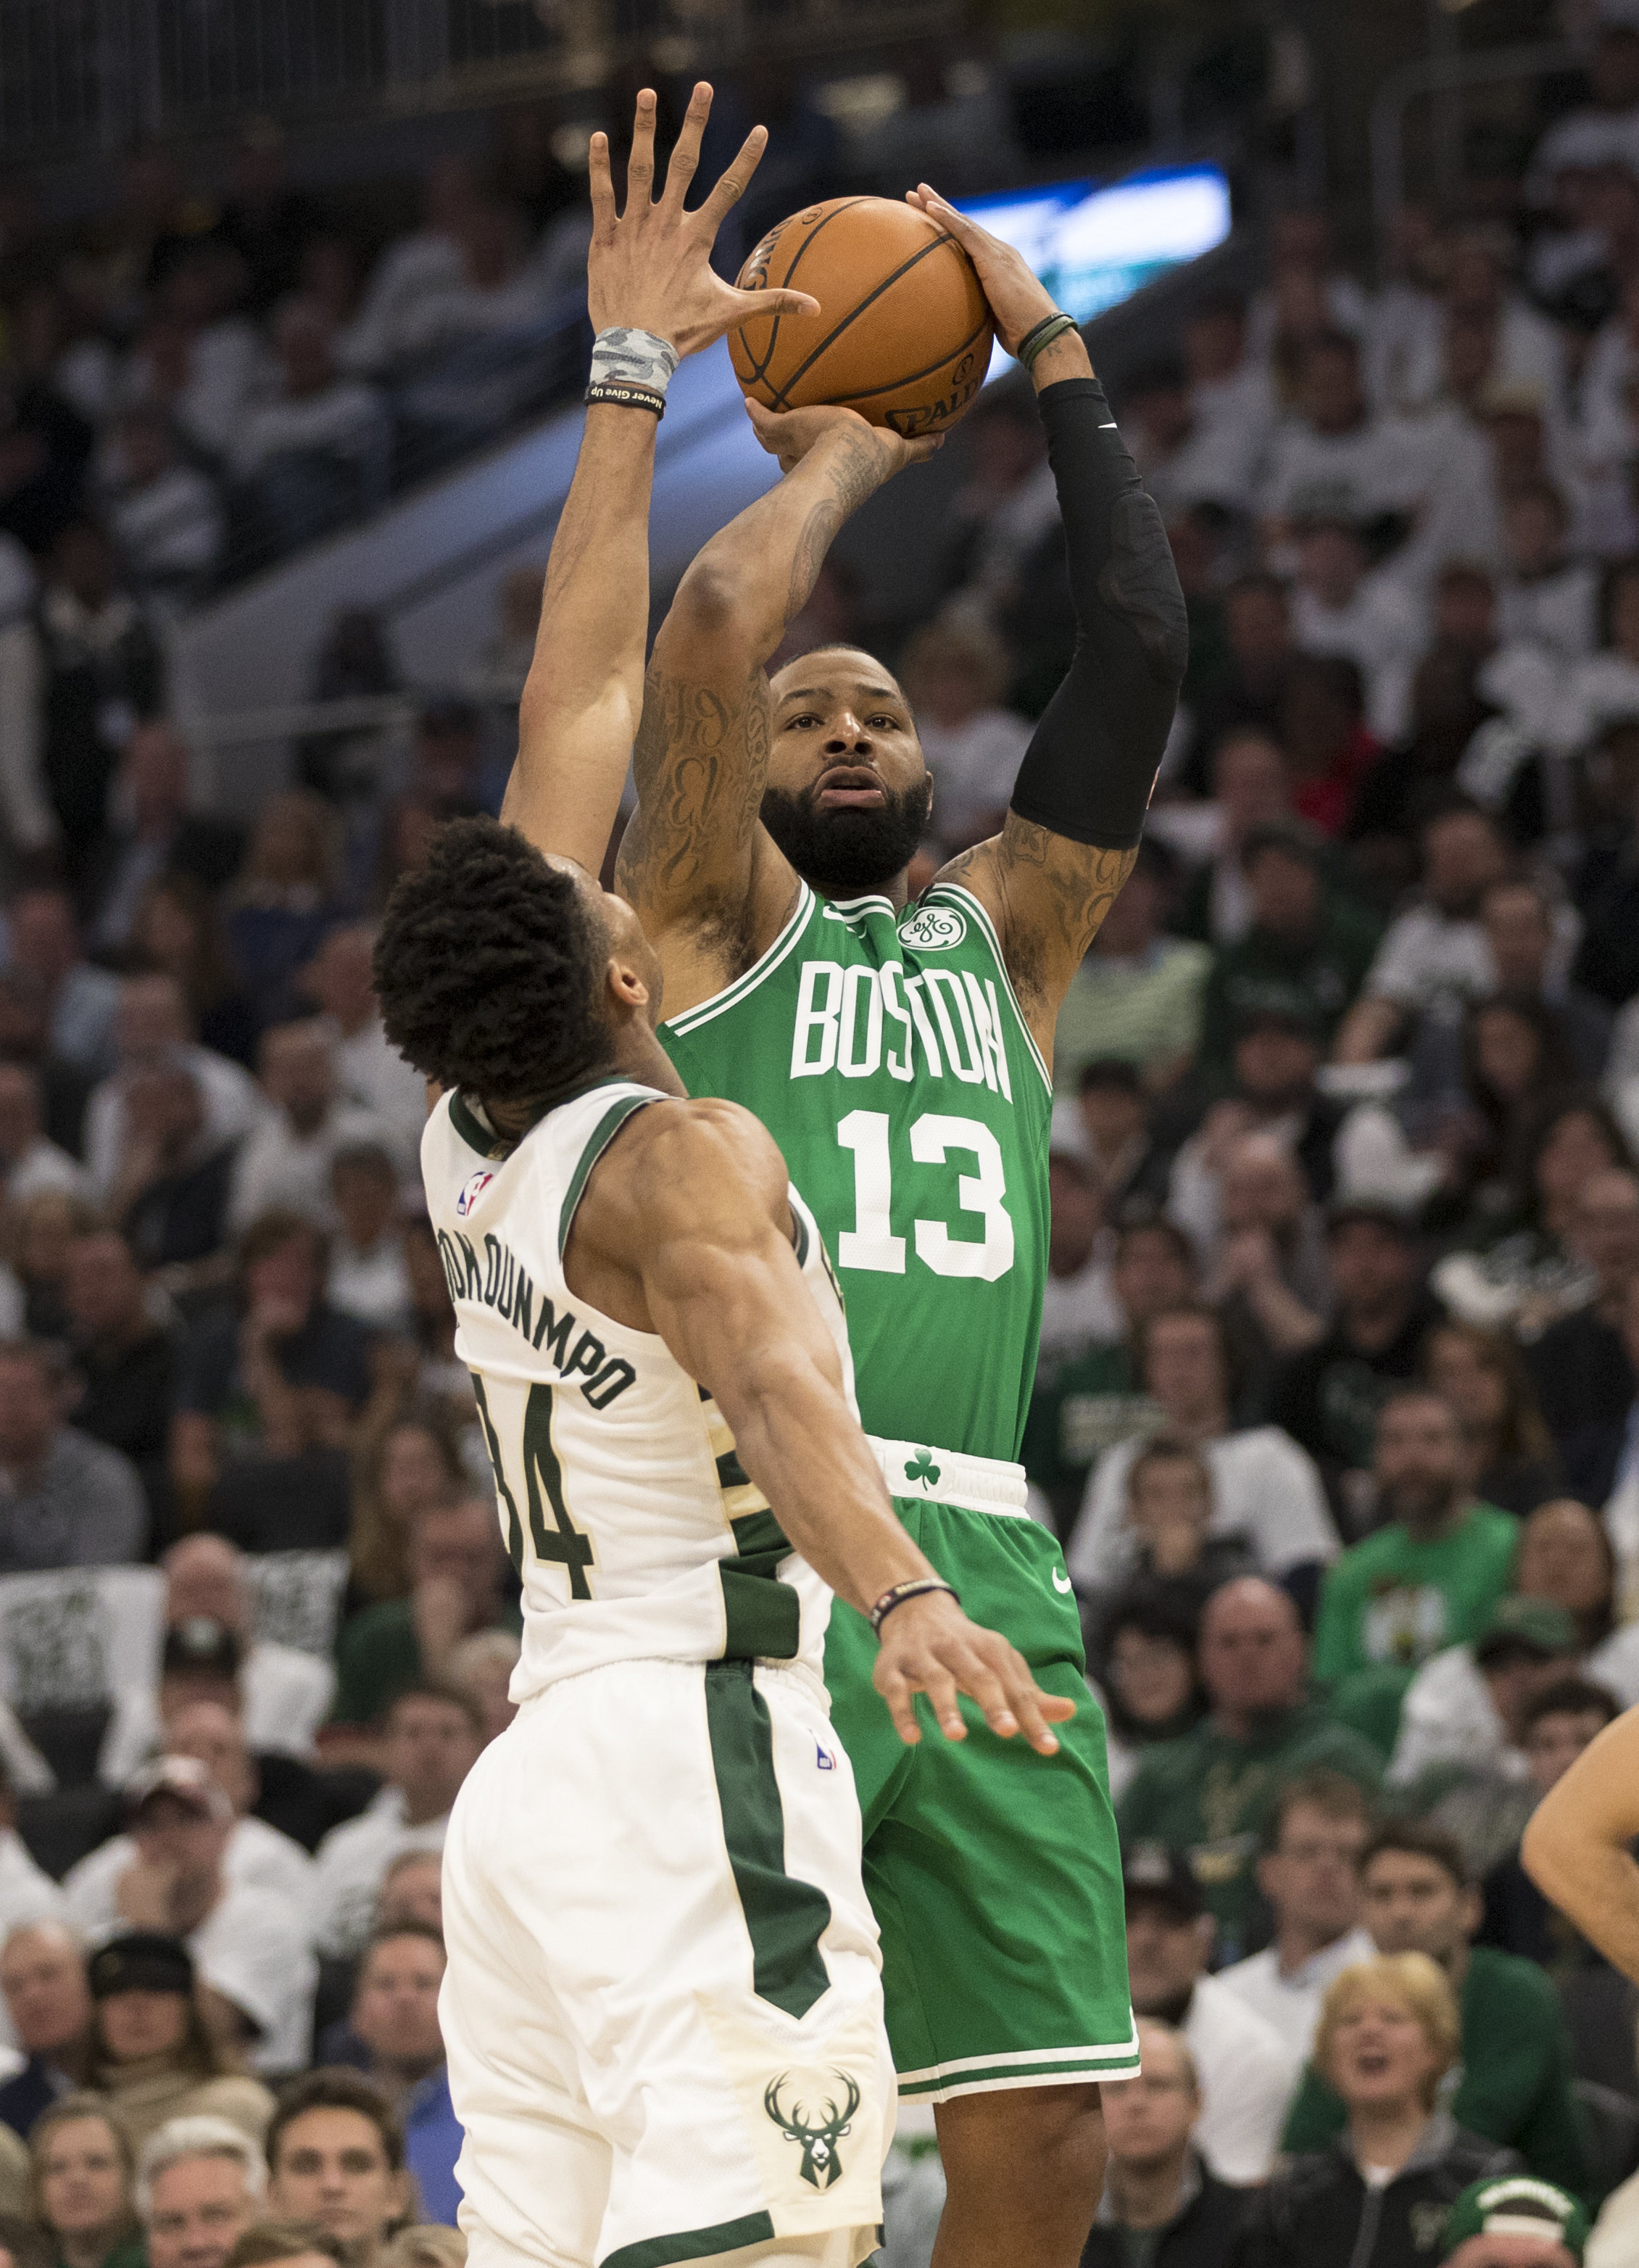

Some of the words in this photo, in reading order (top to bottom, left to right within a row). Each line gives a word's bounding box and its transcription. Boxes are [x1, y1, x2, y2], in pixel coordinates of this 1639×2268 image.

[591, 386, 603, 397] Up
[605, 389, 631, 399] Give
[632, 392, 663, 409] Never
[789, 960, 1013, 1105] BOSTON
[837, 1109, 1015, 1283] 13
